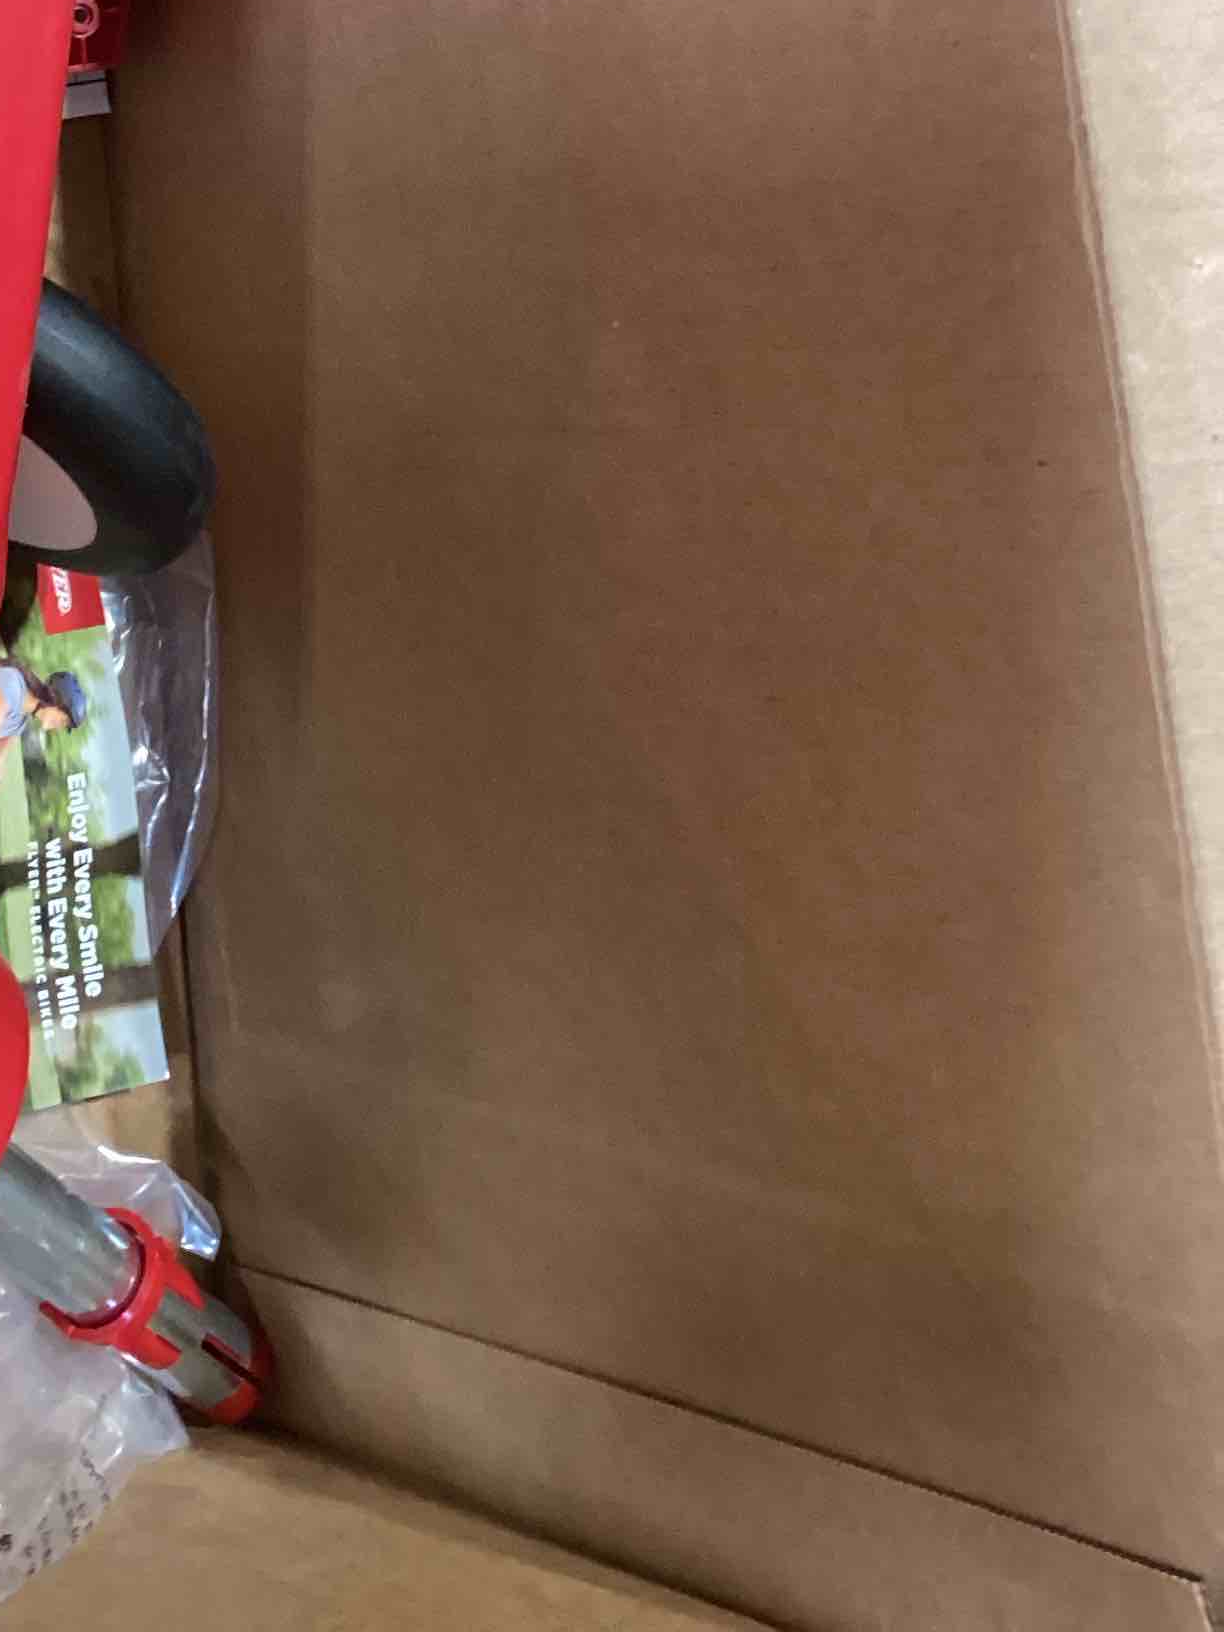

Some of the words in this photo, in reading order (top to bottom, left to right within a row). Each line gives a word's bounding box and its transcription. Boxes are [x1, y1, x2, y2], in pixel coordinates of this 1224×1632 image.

[67, 772, 89, 844] Enjoy
[45, 837, 67, 895] with
[73, 847, 94, 920] Every
[47, 897, 70, 970] Every
[79, 924, 104, 998] Smile
[30, 905, 46, 984] ELECTRIC
[38, 990, 54, 1041] BIKES
[55, 975, 80, 1030] Mile
